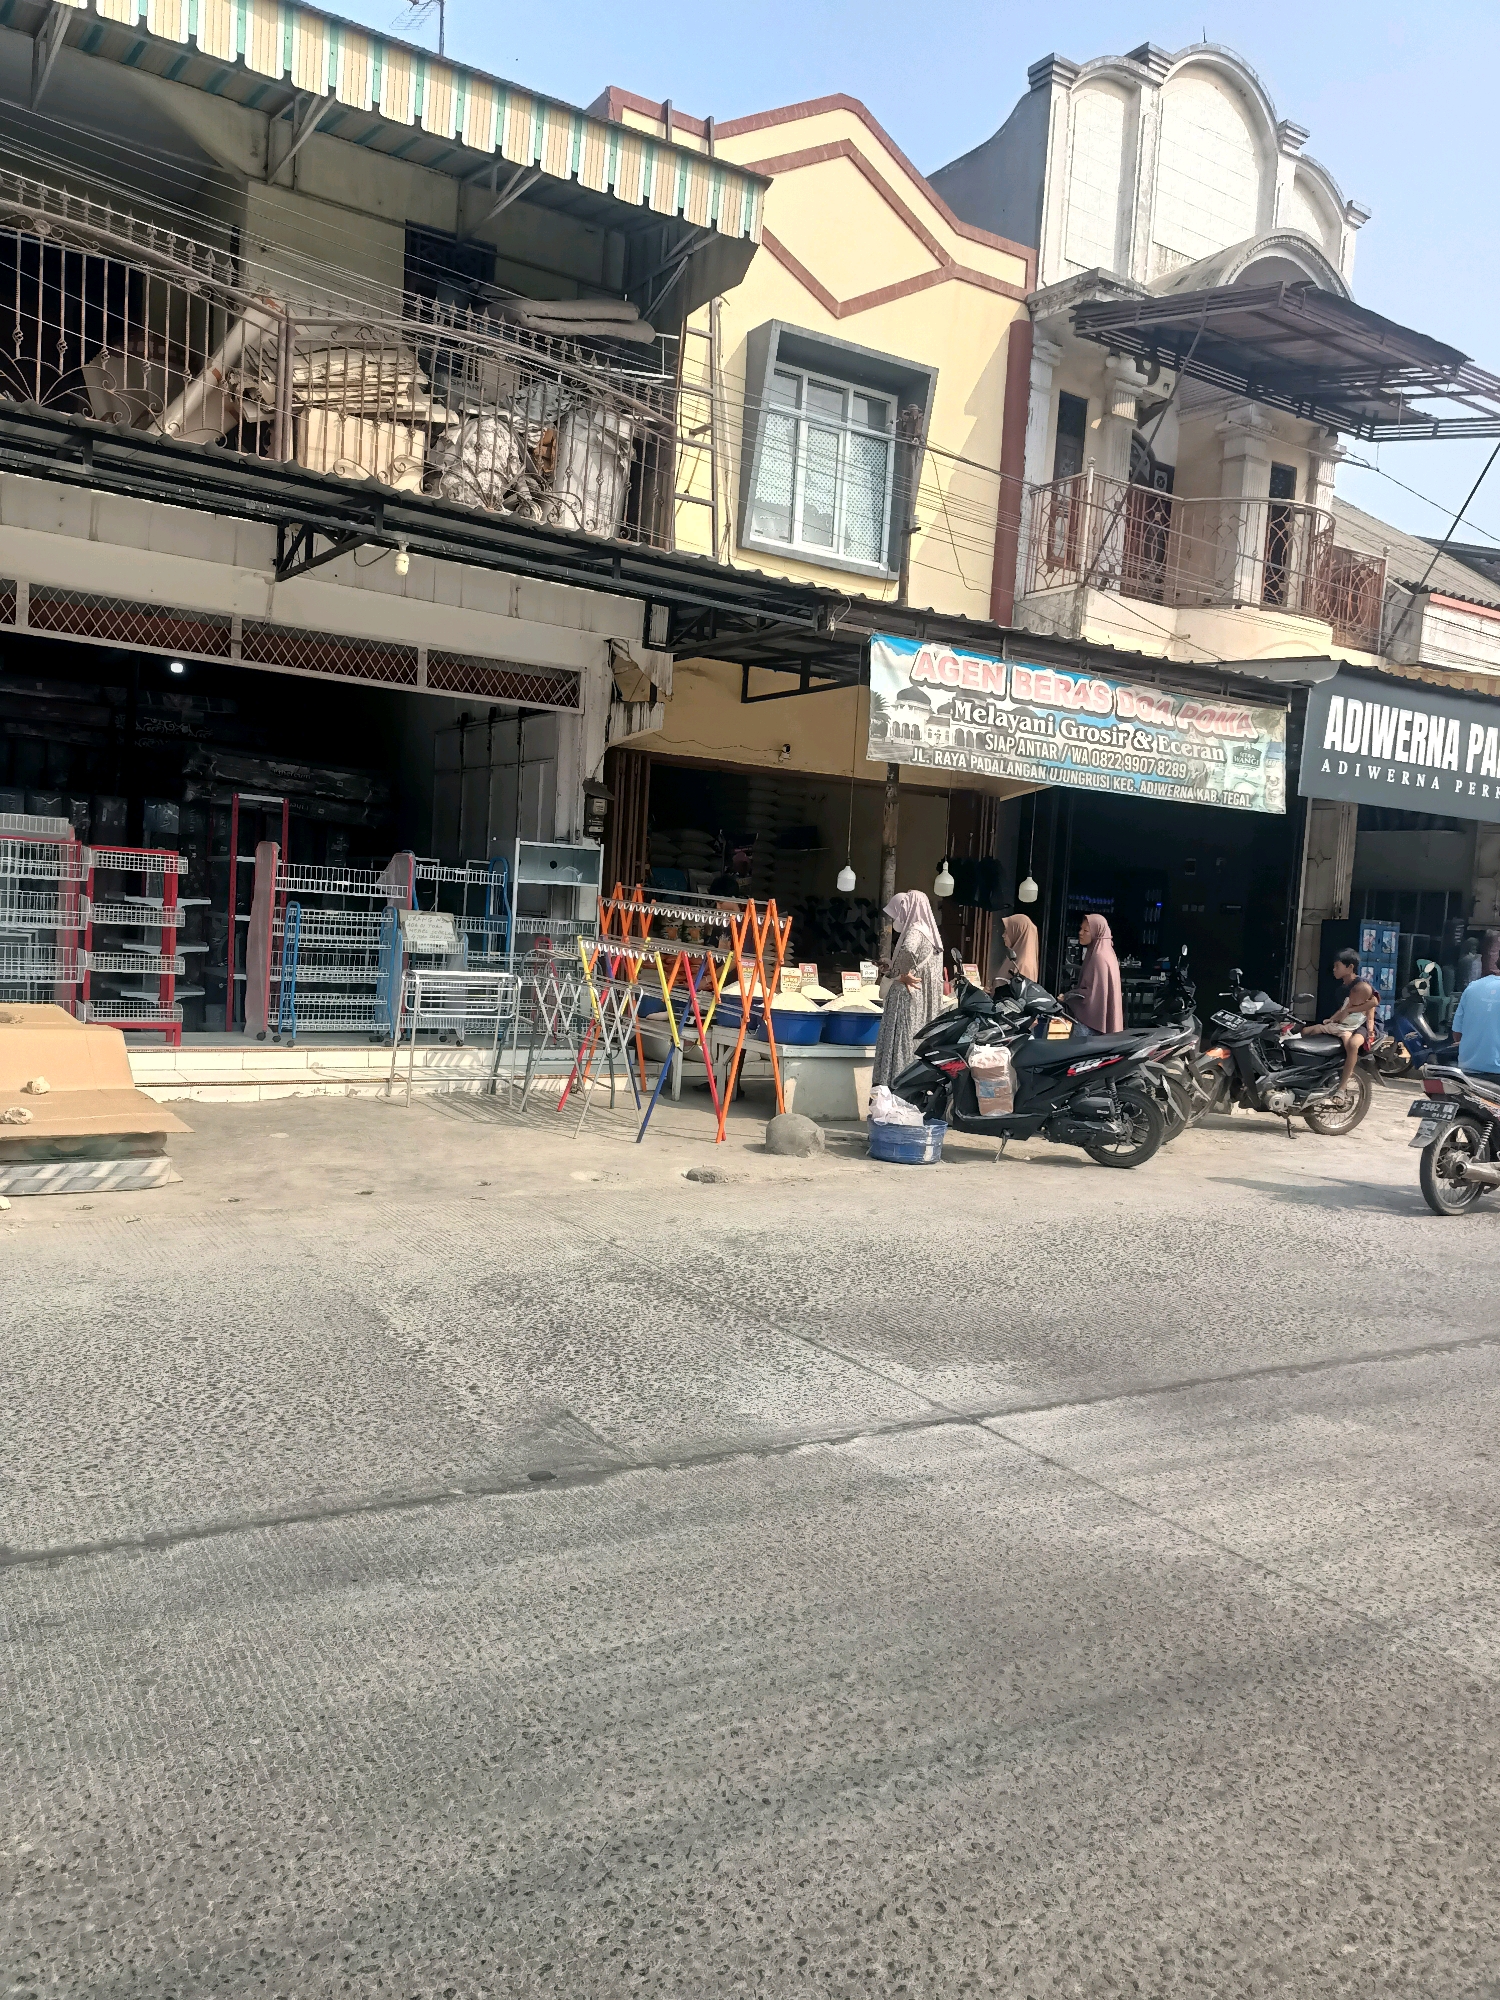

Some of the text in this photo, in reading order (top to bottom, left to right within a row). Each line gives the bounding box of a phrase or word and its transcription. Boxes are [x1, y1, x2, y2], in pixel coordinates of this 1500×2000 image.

[913, 649, 1254, 737] AGEN BERAS DOA POMA
[953, 701, 1224, 762] Melayani Grosir & Eceran
[985, 734, 1186, 778] SIAP ANTAR / WA 0822 9907 8289
[1233, 755, 1260, 765] WANGI
[1323, 695, 1500, 778] ADIWERNA PA
[911, 747, 1252, 808] JL. RAYA PADALANGAN UJUNGRUSI KEC. ADIWERNA KAB. TEGAL
[1321, 759, 1440, 789] ADIWERNA
